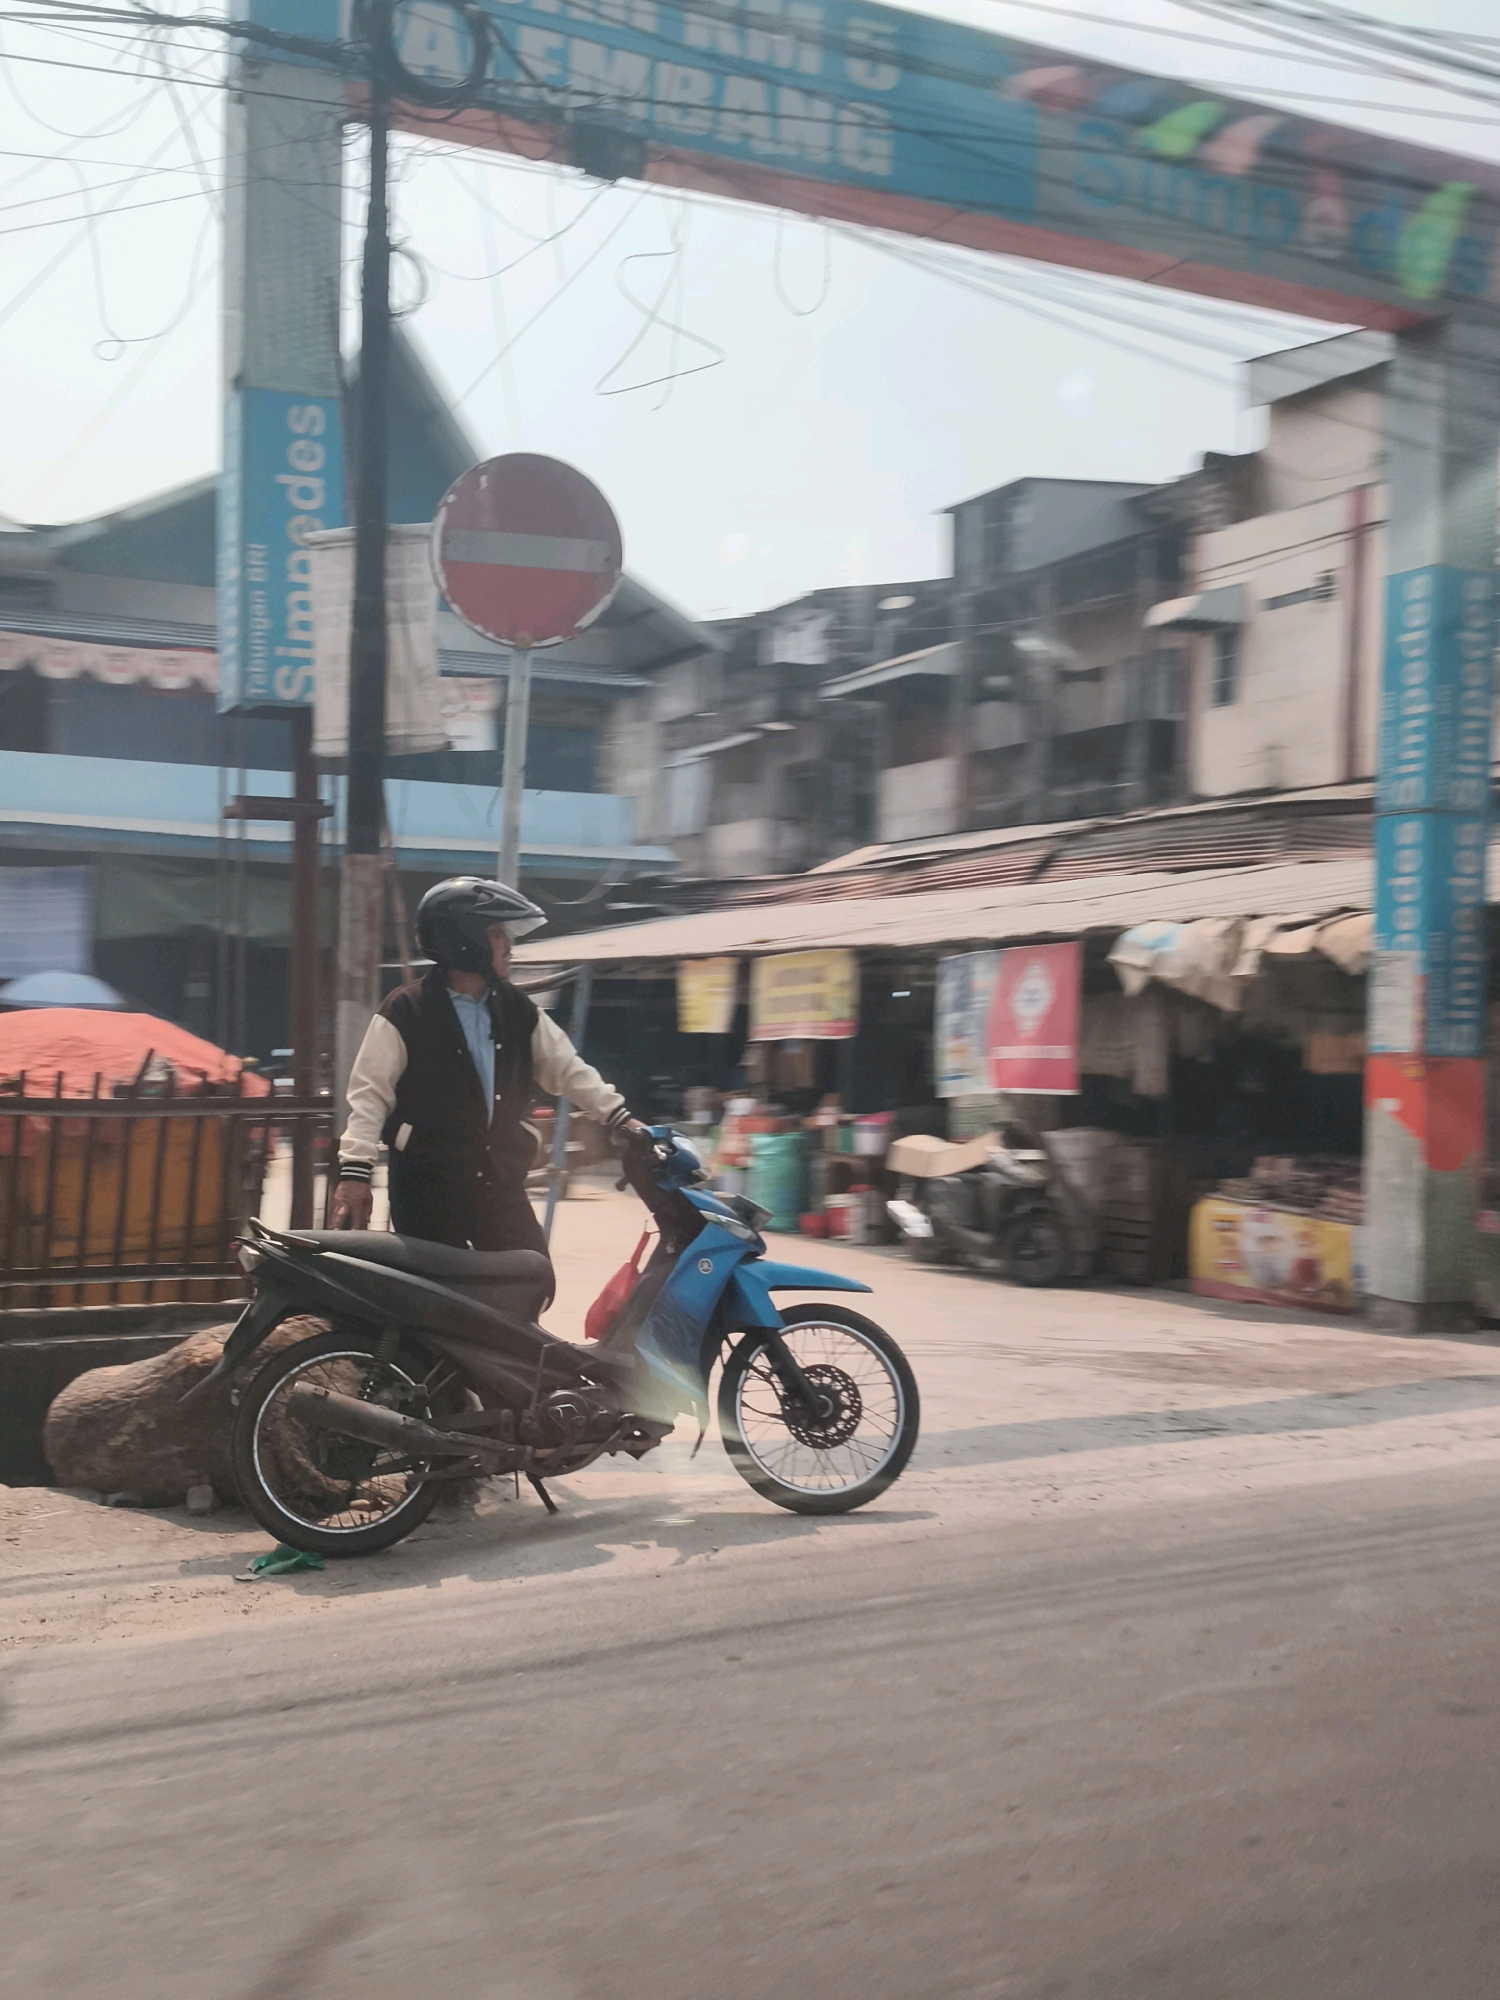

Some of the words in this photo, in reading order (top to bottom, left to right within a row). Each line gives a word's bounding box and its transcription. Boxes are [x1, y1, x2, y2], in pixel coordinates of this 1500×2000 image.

[380, 0, 893, 176] AEMBANG
[1074, 119, 1492, 294] Simpeds
[246, 542, 269, 582] BRI
[246, 589, 272, 697] Tabungan
